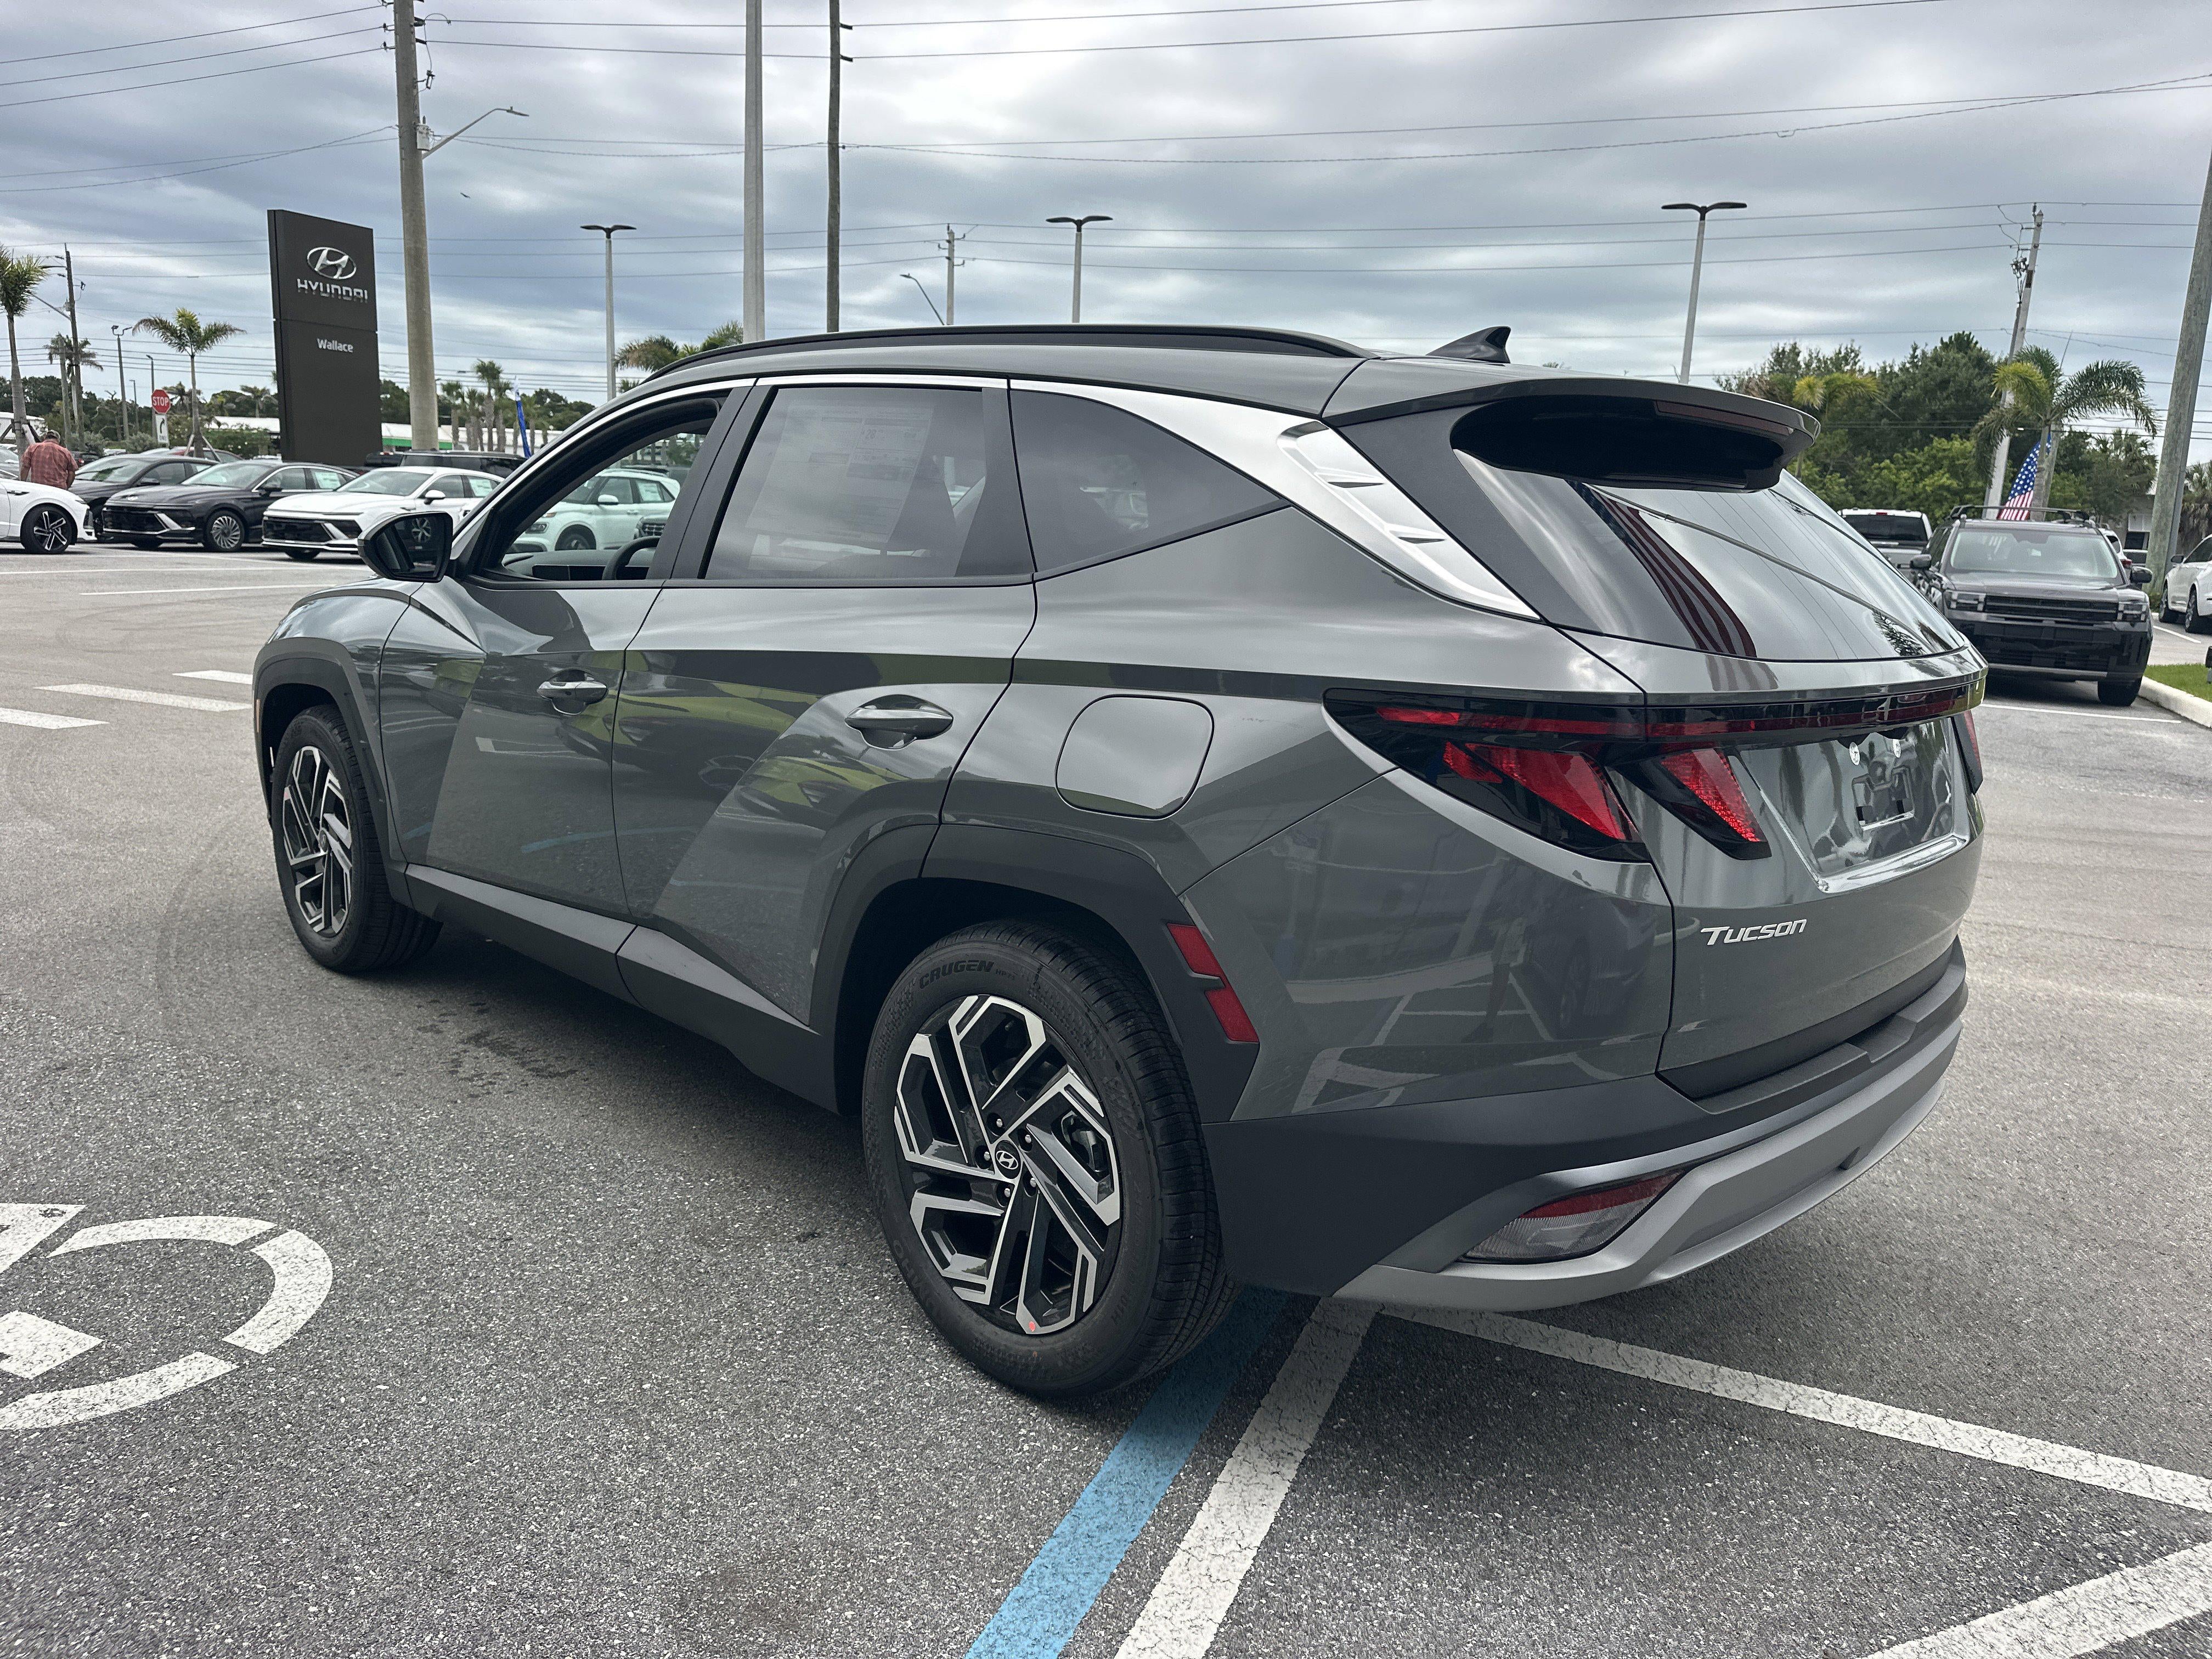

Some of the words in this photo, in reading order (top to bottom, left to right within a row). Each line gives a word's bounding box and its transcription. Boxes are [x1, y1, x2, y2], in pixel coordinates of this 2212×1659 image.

[297, 278, 368, 303] HYUNDAI
[317, 338, 353, 353] Wallace
[153, 397, 169, 407] STOP
